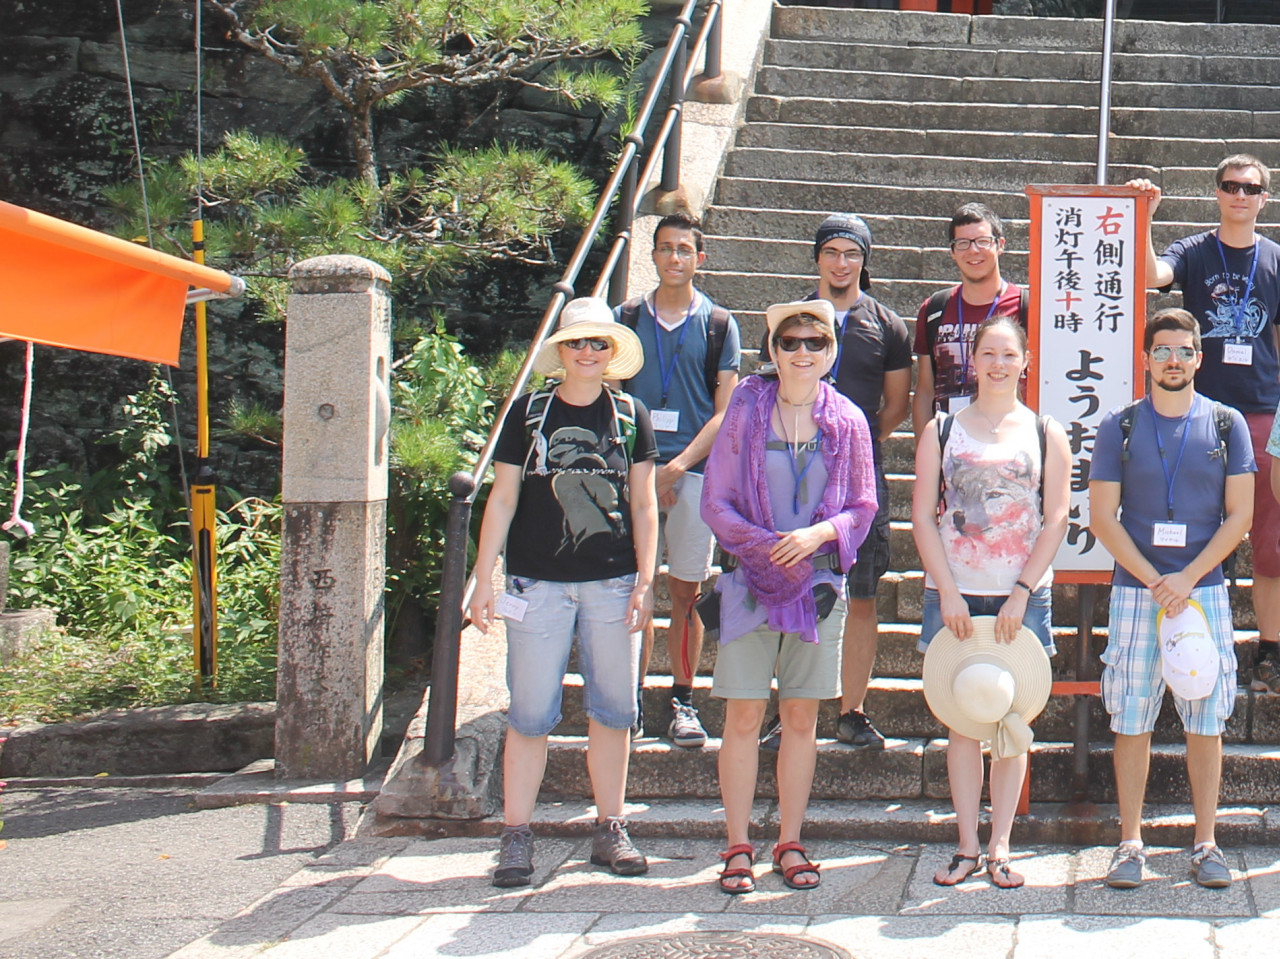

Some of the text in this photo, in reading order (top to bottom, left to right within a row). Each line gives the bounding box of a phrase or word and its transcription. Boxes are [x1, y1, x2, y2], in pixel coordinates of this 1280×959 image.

[1053, 207, 1084, 333] 消灯午後十時
[1093, 206, 1125, 333] 右側通行
[1204, 274, 1220, 287] Born
